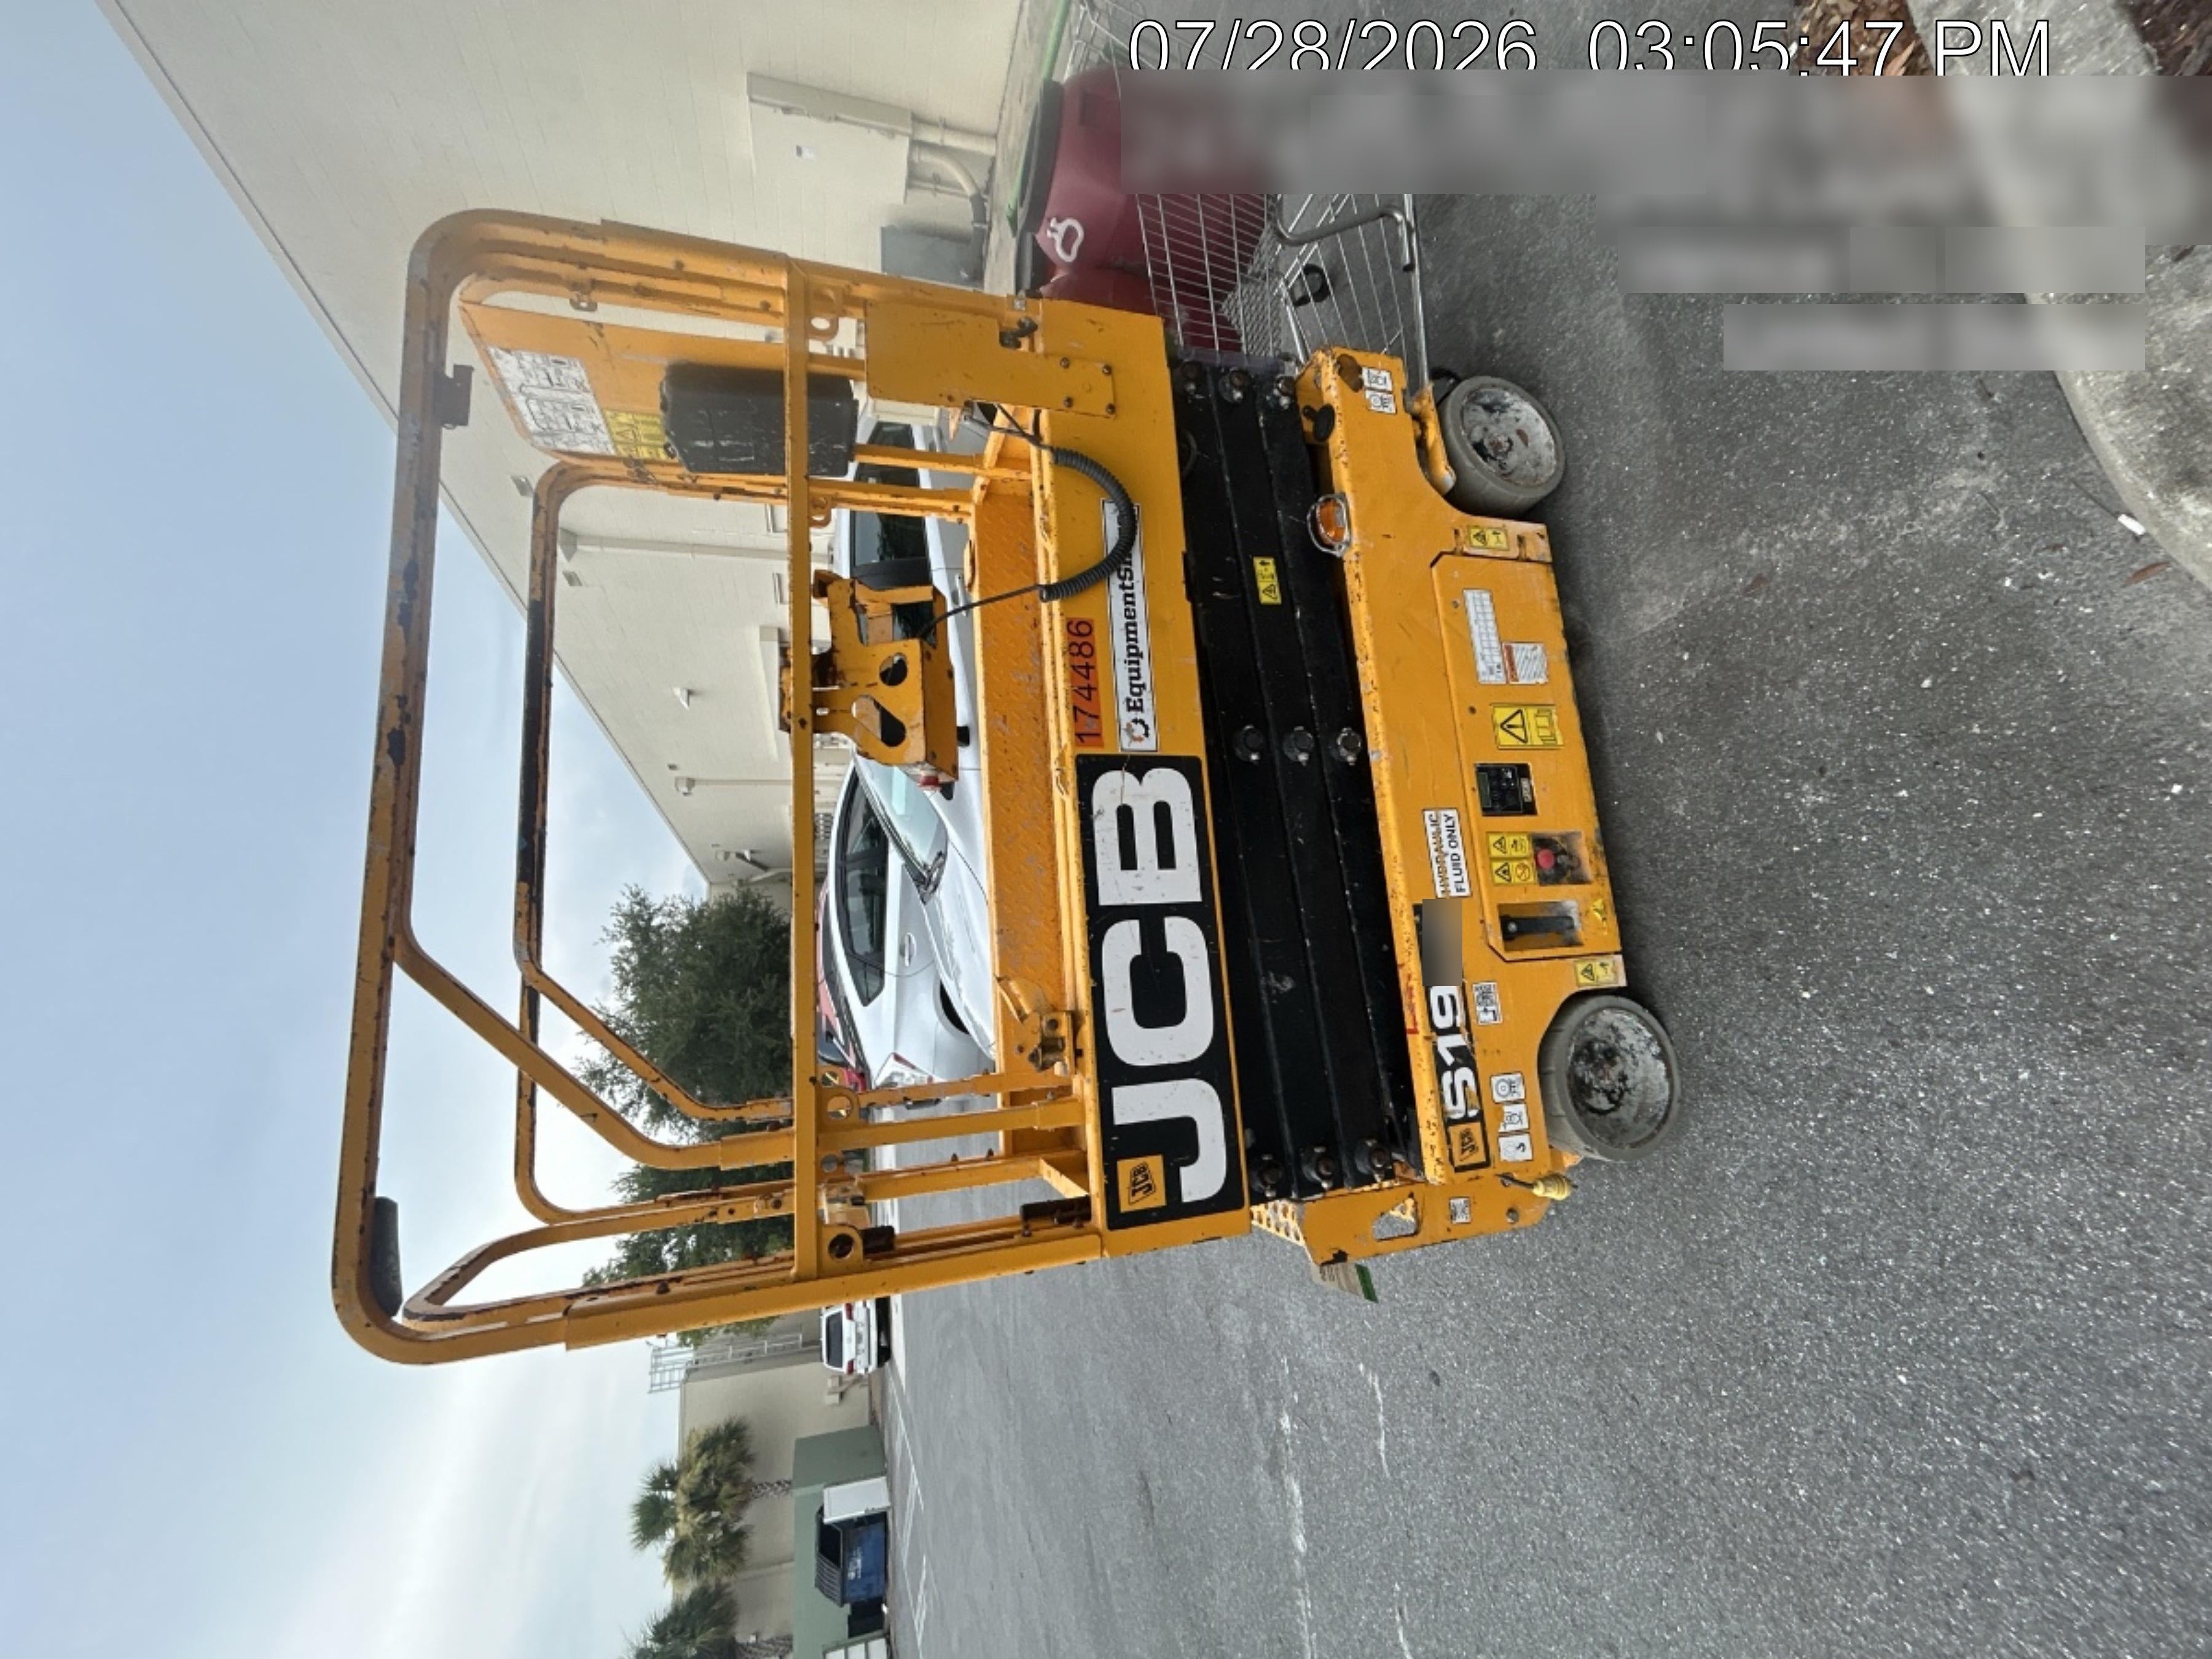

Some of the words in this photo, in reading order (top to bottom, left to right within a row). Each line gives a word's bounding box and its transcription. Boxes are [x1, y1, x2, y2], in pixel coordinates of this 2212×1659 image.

[1067, 619, 1100, 743] 174486
[1443, 814, 1458, 848] ONLY
[1450, 852, 1465, 892] FLUID
[1092, 767, 1226, 1202] JCB
[1131, 1164, 1153, 1197] JCB
